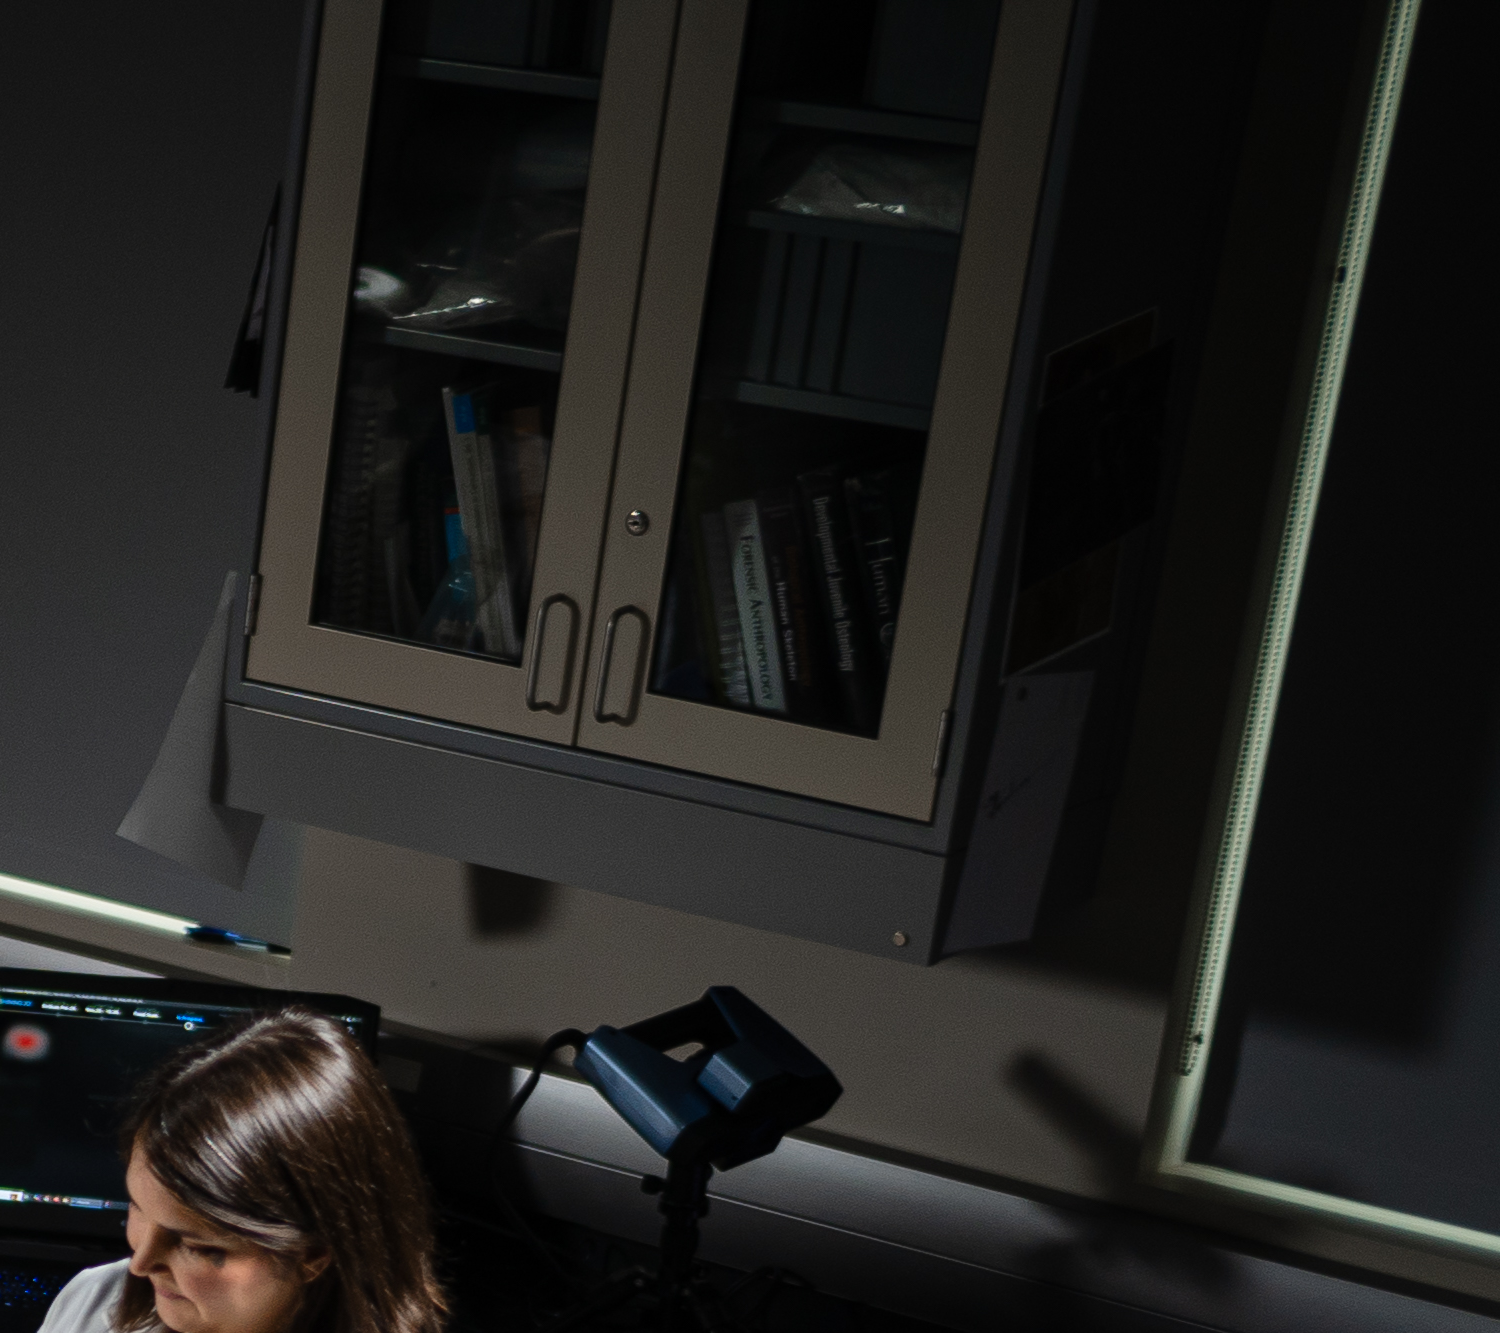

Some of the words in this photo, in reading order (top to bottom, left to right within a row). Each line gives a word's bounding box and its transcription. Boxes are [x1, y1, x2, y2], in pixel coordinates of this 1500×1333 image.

[812, 496, 843, 574] Developmental
[826, 576, 849, 620] Juvenile
[865, 537, 895, 616] Human
[775, 581, 790, 626] Human
[782, 629, 798, 682] Skeleton
[834, 620, 855, 672] Osteology
